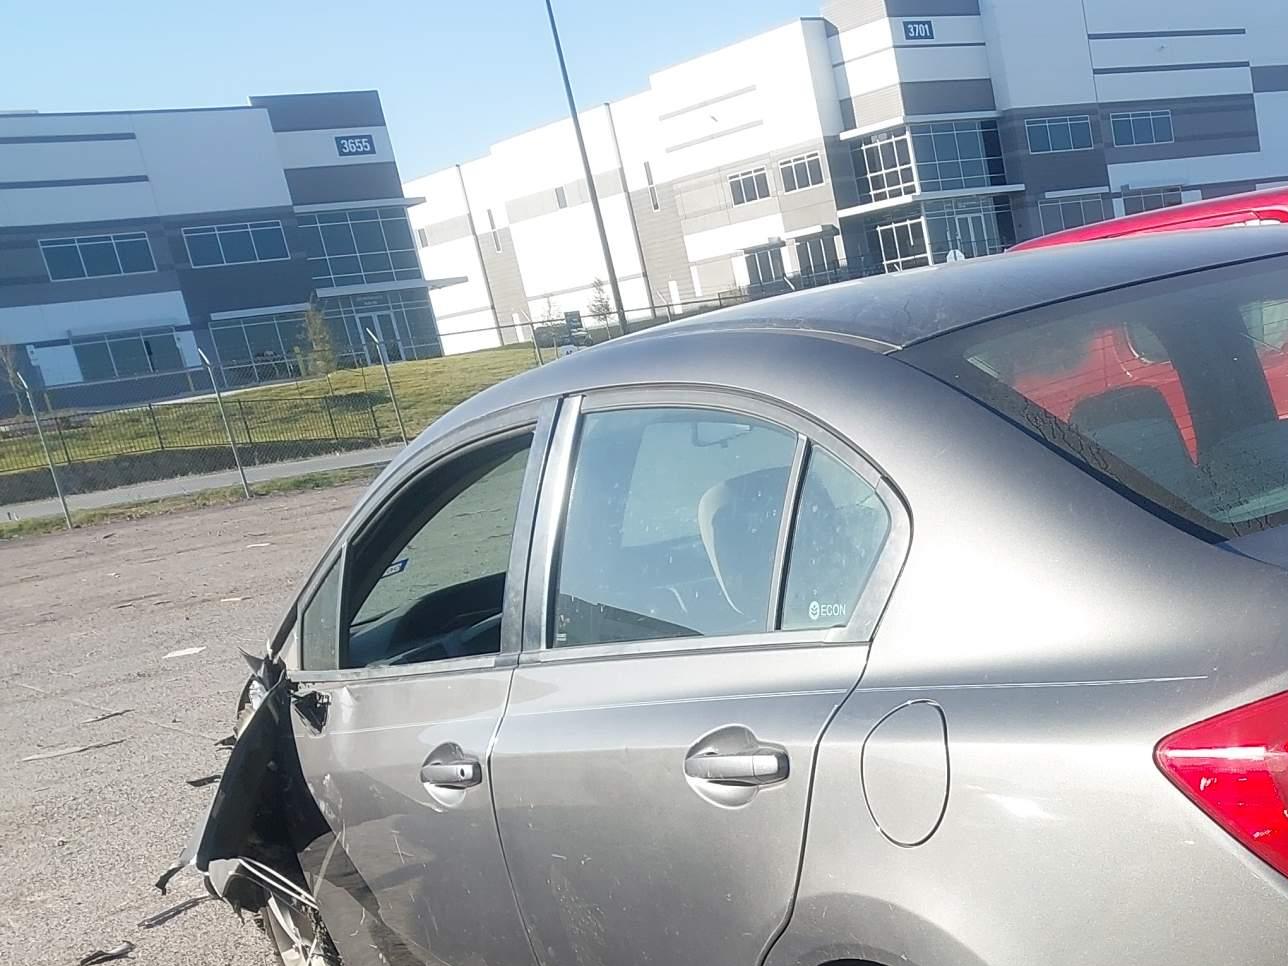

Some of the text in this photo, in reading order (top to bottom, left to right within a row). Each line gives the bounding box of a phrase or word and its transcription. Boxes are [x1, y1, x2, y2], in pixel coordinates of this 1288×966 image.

[907, 23, 930, 37] 3701
[340, 138, 371, 153] 3655
[820, 603, 846, 616] ECON
